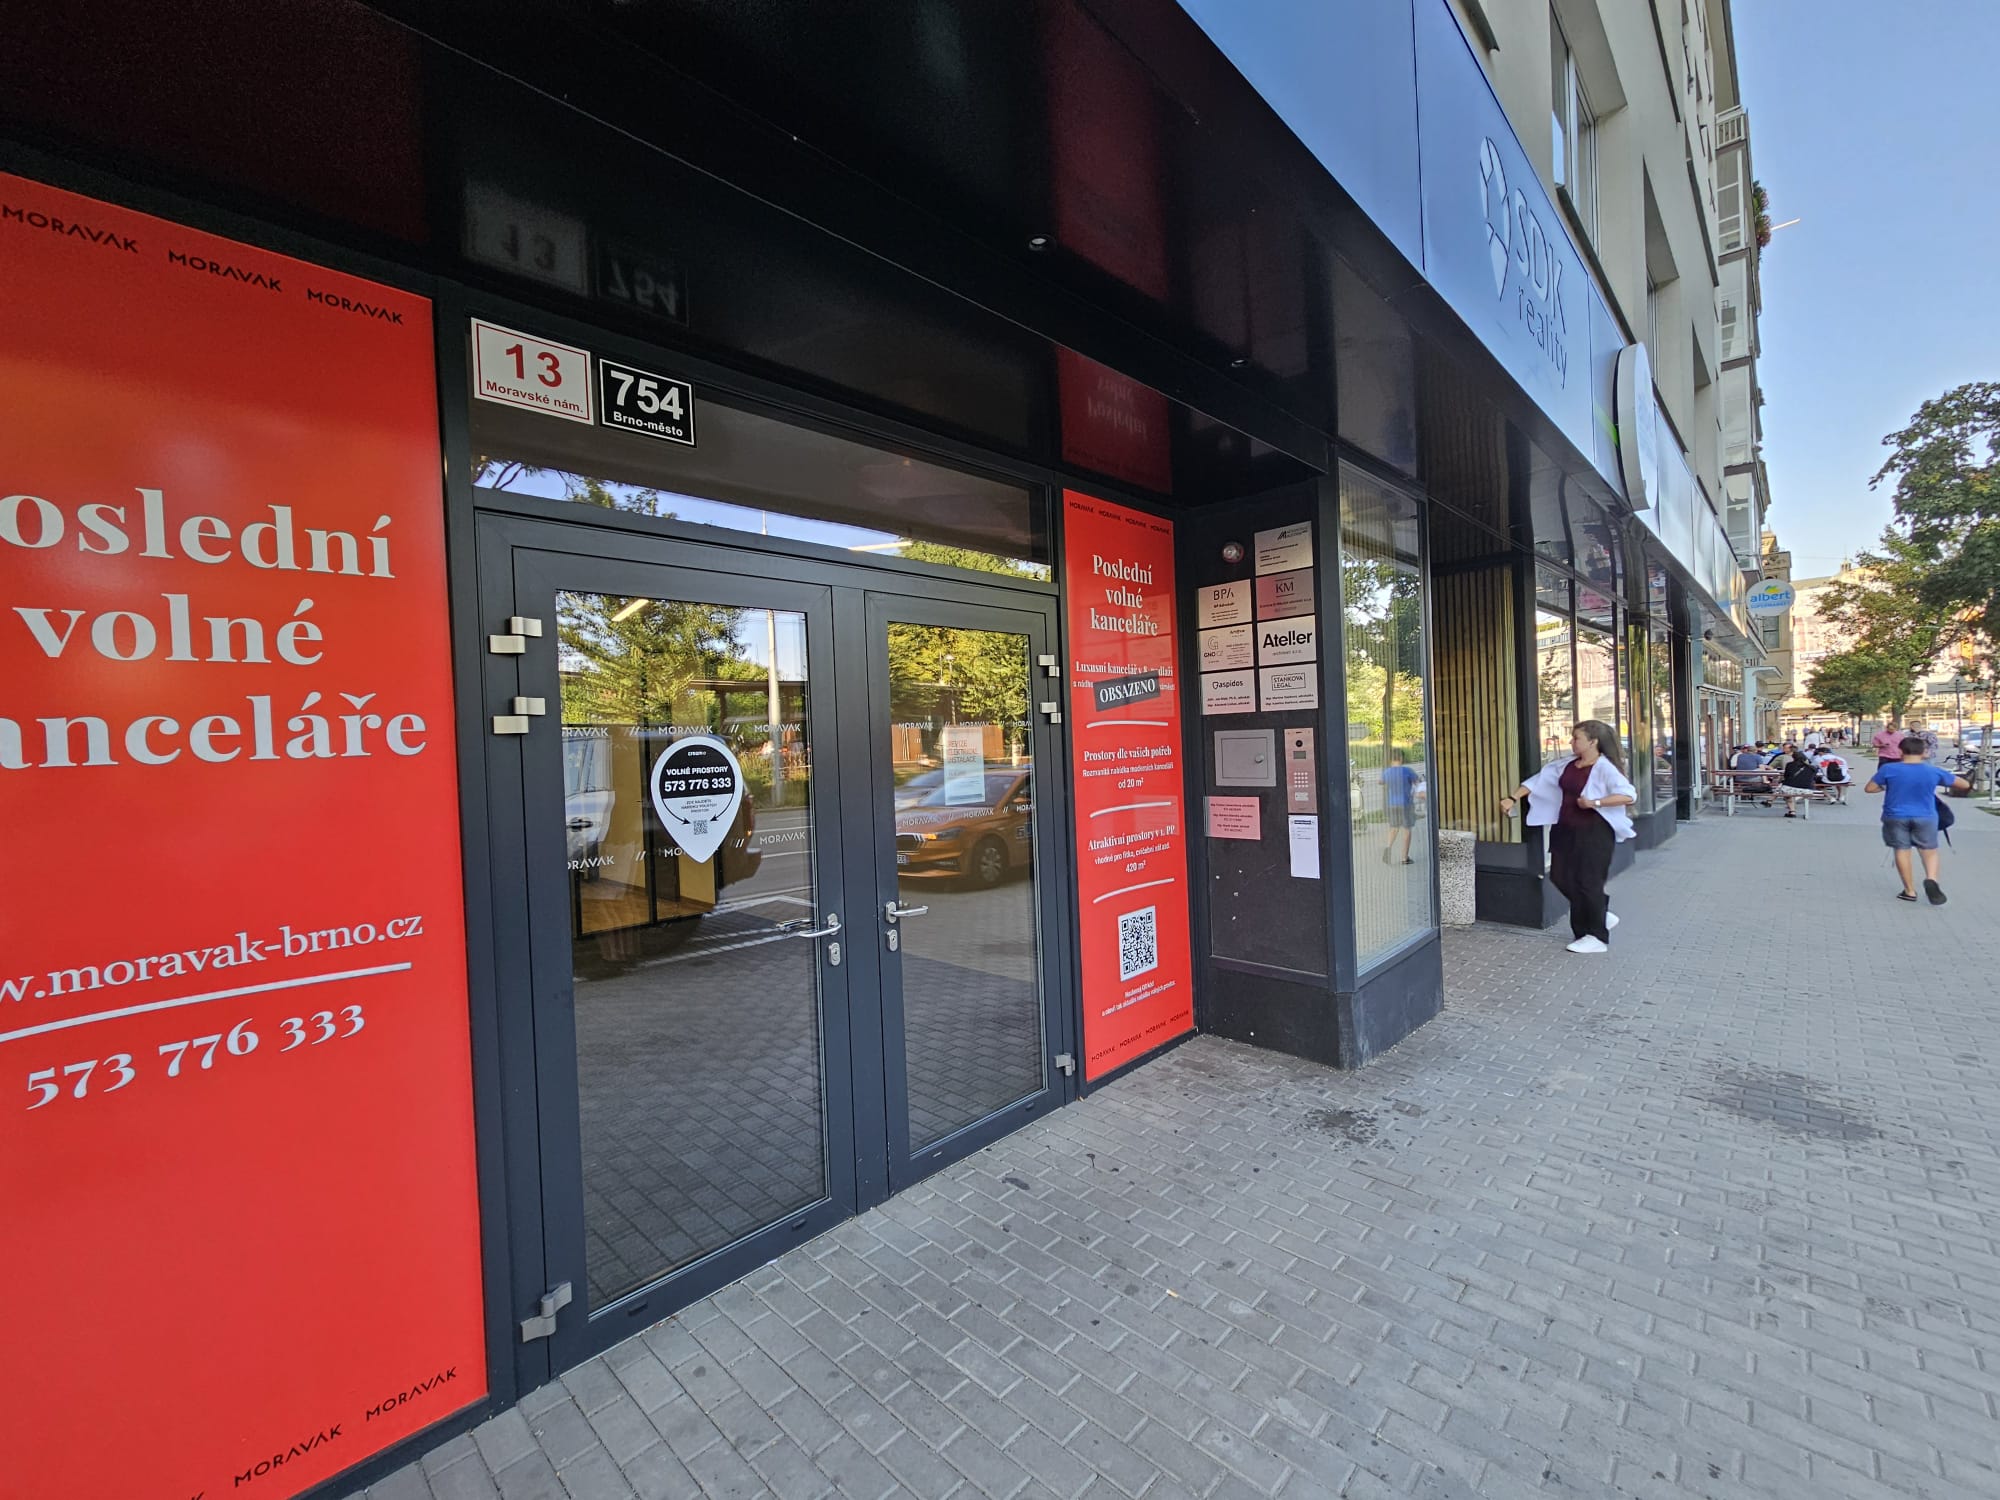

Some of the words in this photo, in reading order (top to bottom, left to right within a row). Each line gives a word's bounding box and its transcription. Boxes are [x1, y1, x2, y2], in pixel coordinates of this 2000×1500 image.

[2, 205, 139, 254] MORAVAK
[168, 249, 282, 293] MORAVAK
[307, 288, 403, 324] MORAVAK
[1514, 187, 1566, 335] SDK
[1518, 286, 1567, 391] reality
[505, 343, 562, 388] 13
[486, 380, 550, 405] Moravské
[554, 393, 584, 413] nám.
[611, 370, 684, 420] 754
[613, 412, 683, 437] Brno-město
[1092, 554, 1152, 584] Poslední
[1105, 586, 1143, 609] volné
[1275, 581, 1294, 594] KM
[1750, 591, 1791, 602] albert
[13, 593, 323, 665] volné
[1090, 608, 1158, 636] kanceláře
[1075, 660, 1106, 673] Luxusní
[1099, 679, 1156, 703] OBSAZENO
[658, 726, 713, 735] MORAVAK
[754, 724, 800, 733] MORAVAK
[1084, 750, 1115, 761] Prostory
[1117, 748, 1128, 759] dle
[666, 767, 691, 776] VOLNÉ
[692, 766, 728, 775] PROSTORY
[1118, 779, 1126, 789] od
[1127, 778, 1135, 788] 20
[664, 781, 686, 792] 573
[688, 779, 709, 790] 776
[712, 778, 731, 789] 333
[760, 831, 805, 845] MORAVAK
[1088, 832, 1125, 851] Atraktivní
[1126, 830, 1154, 845] prostory
[1166, 825, 1175, 835] PP
[1125, 863, 1137, 872] 420
[27, 1053, 135, 1109] 573
[159, 1018, 259, 1078] 776
[280, 1005, 365, 1052] 333
[234, 1424, 342, 1487] MORAVAK
[366, 1366, 457, 1422] MORAVAK
